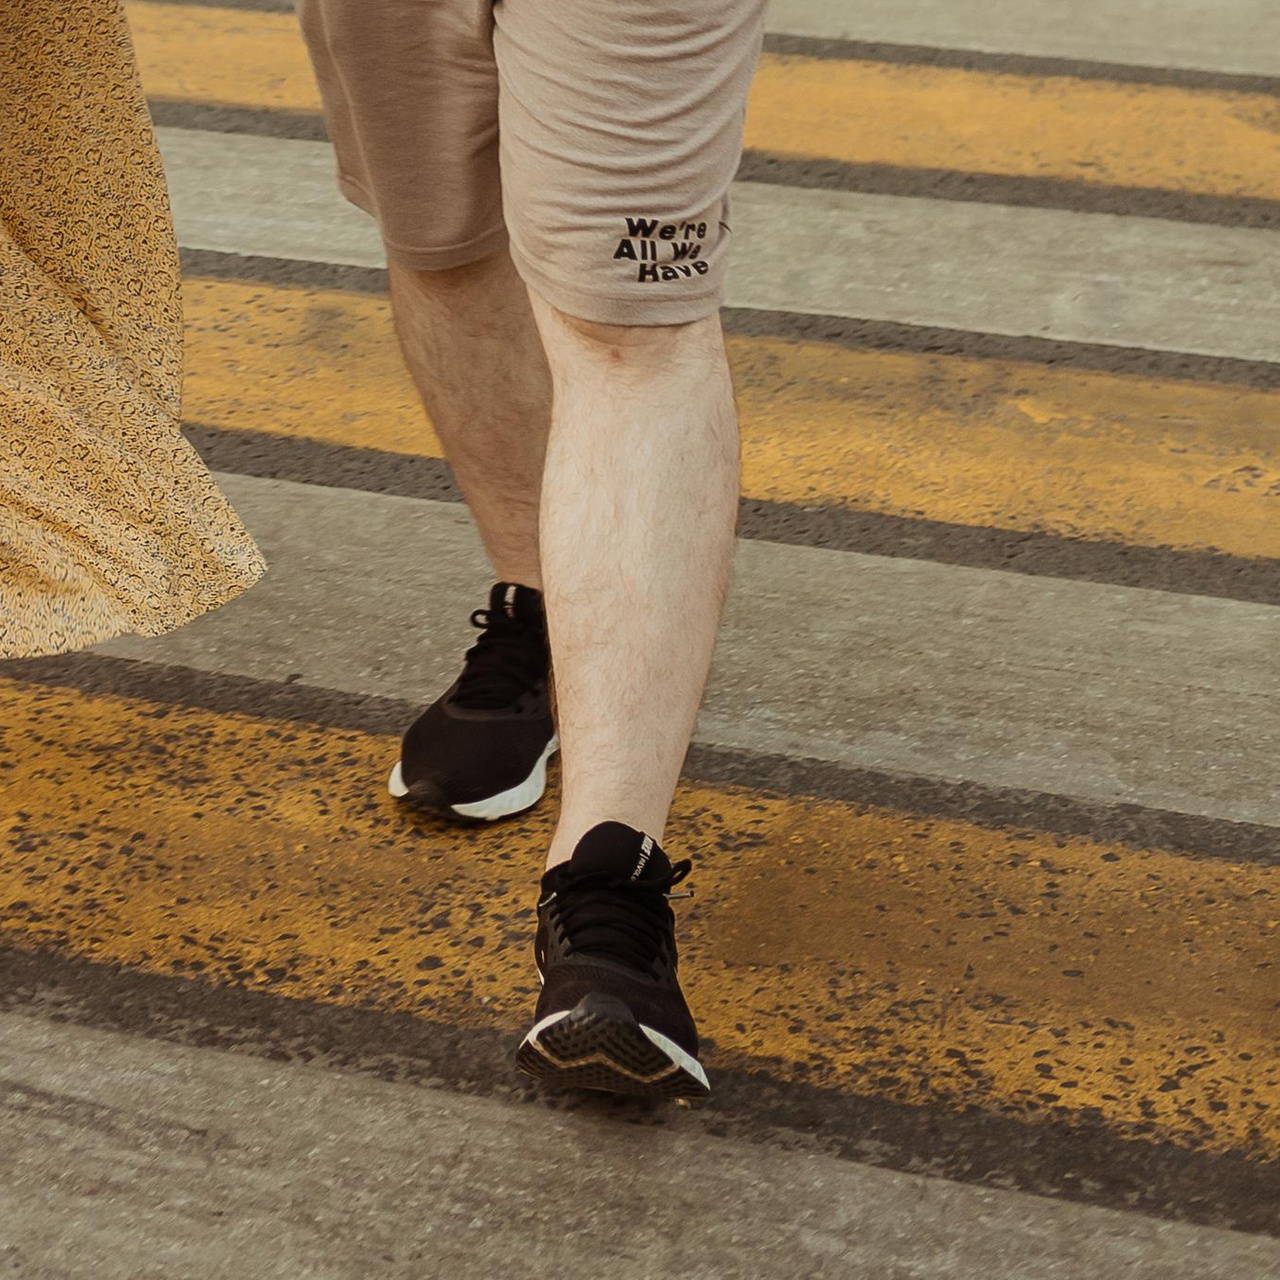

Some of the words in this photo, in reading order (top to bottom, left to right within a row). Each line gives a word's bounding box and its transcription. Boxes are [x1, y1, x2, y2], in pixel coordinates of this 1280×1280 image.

[625, 218, 707, 240] We're
[613, 239, 657, 261] All
[671, 242, 701, 261] We
[638, 260, 709, 282] Have
